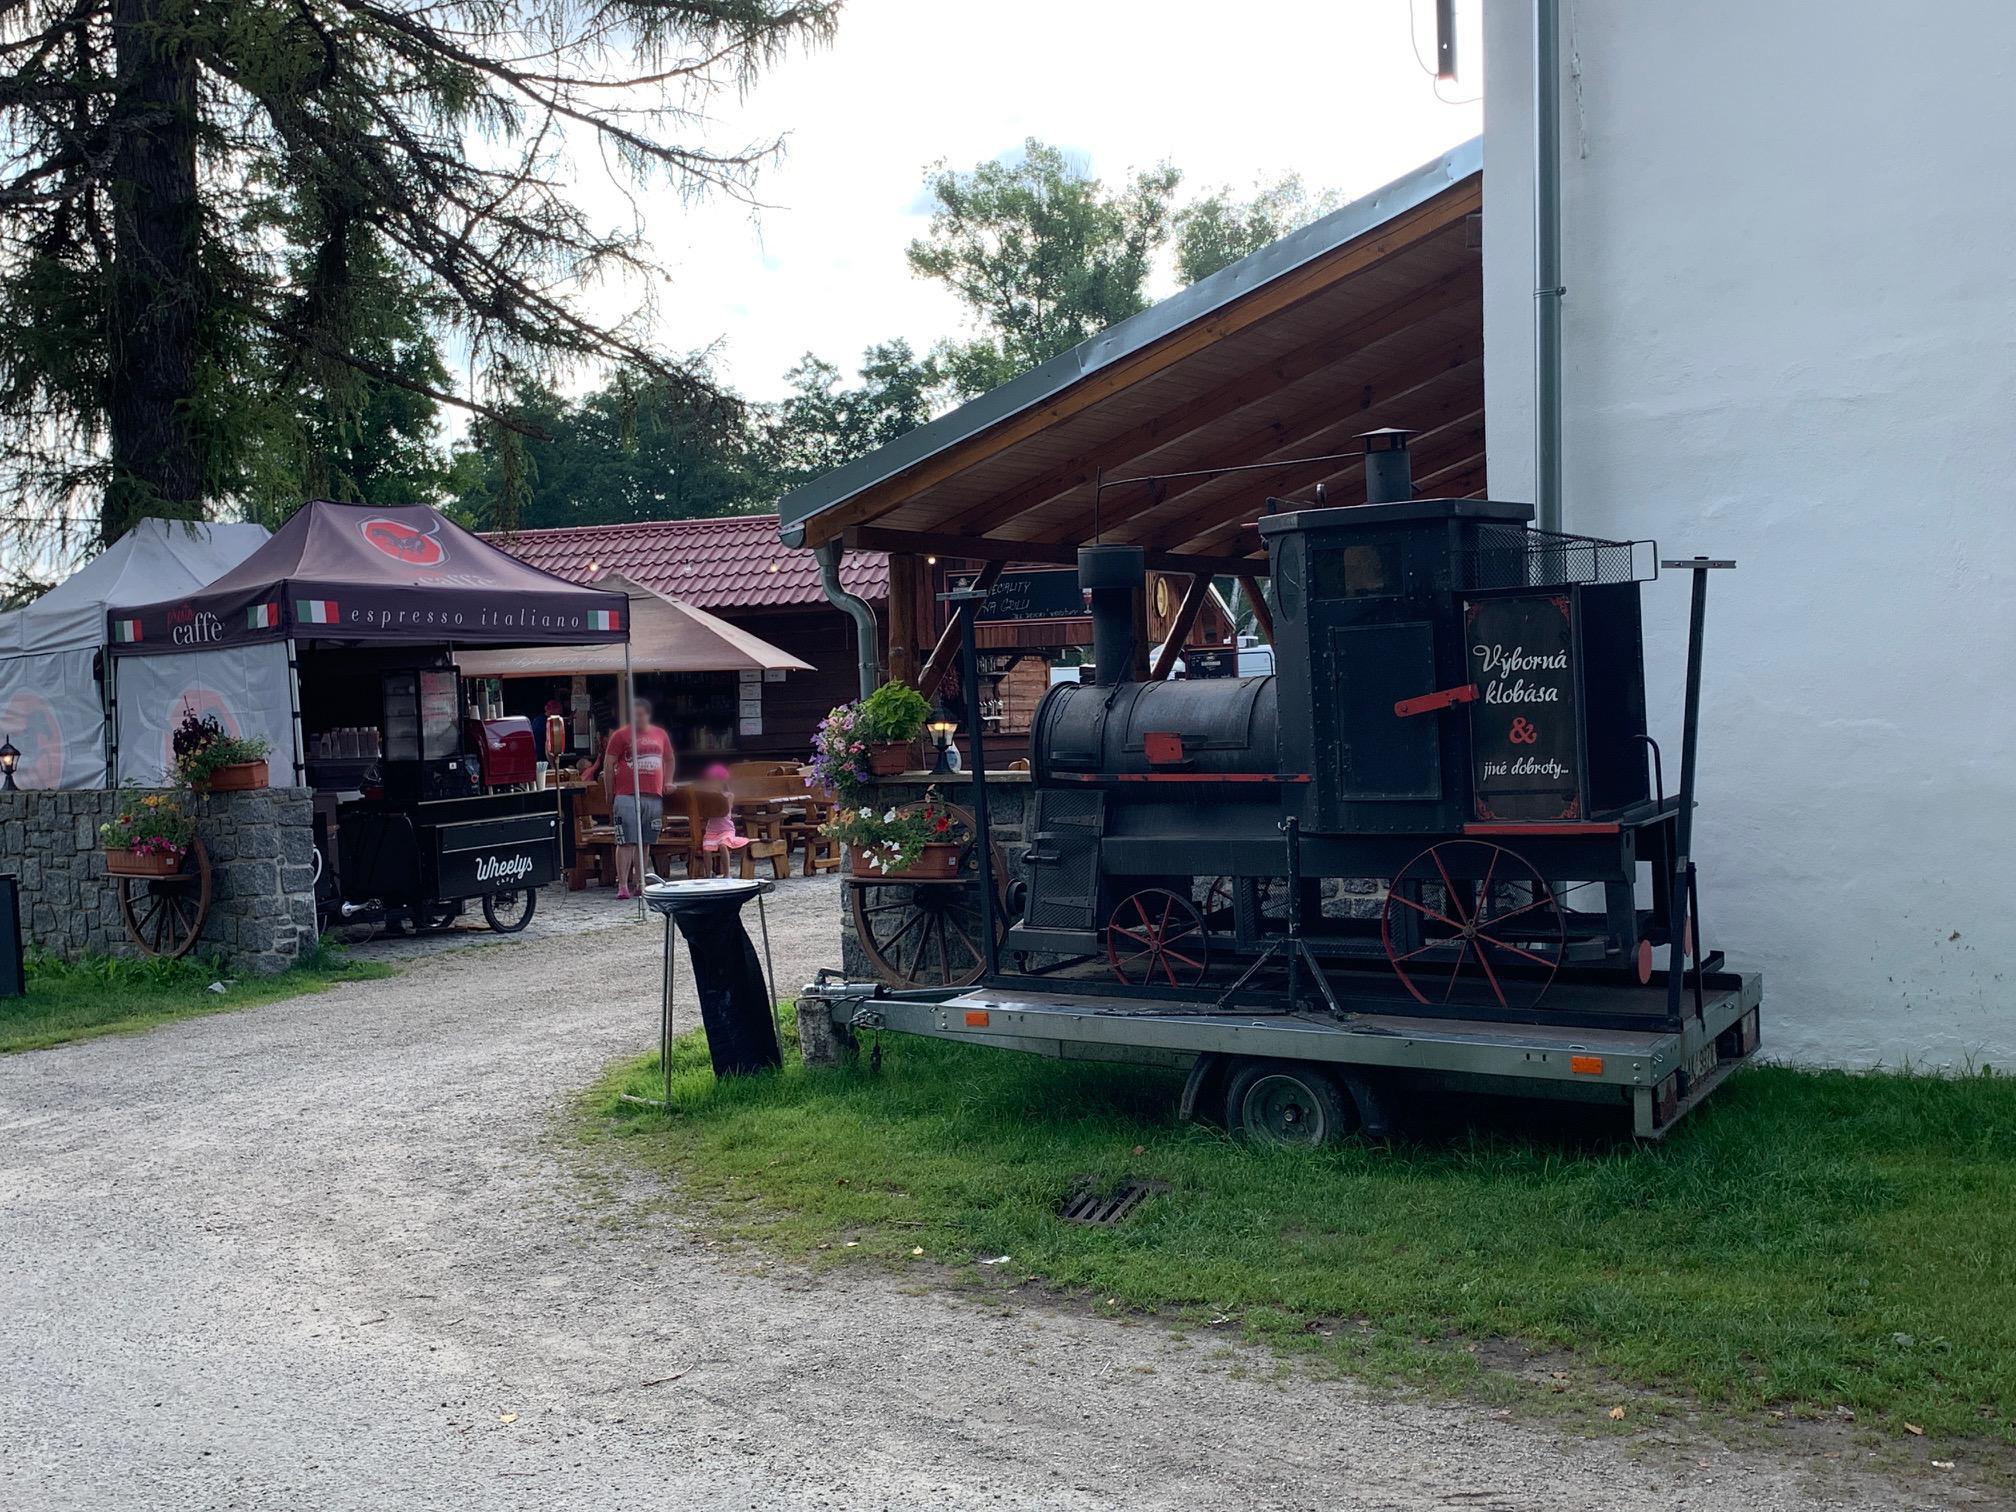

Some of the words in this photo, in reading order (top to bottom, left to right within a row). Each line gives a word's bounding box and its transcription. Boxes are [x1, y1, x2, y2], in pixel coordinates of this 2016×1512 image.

[173, 611, 223, 646] caffè
[351, 608, 463, 628] espresso
[481, 608, 580, 628] italiano
[1472, 644, 1568, 679] Výborná
[1485, 678, 1559, 704] klobása
[1509, 716, 1538, 744] &
[1483, 761, 1507, 781] jiné
[475, 854, 533, 881] Wheelys
